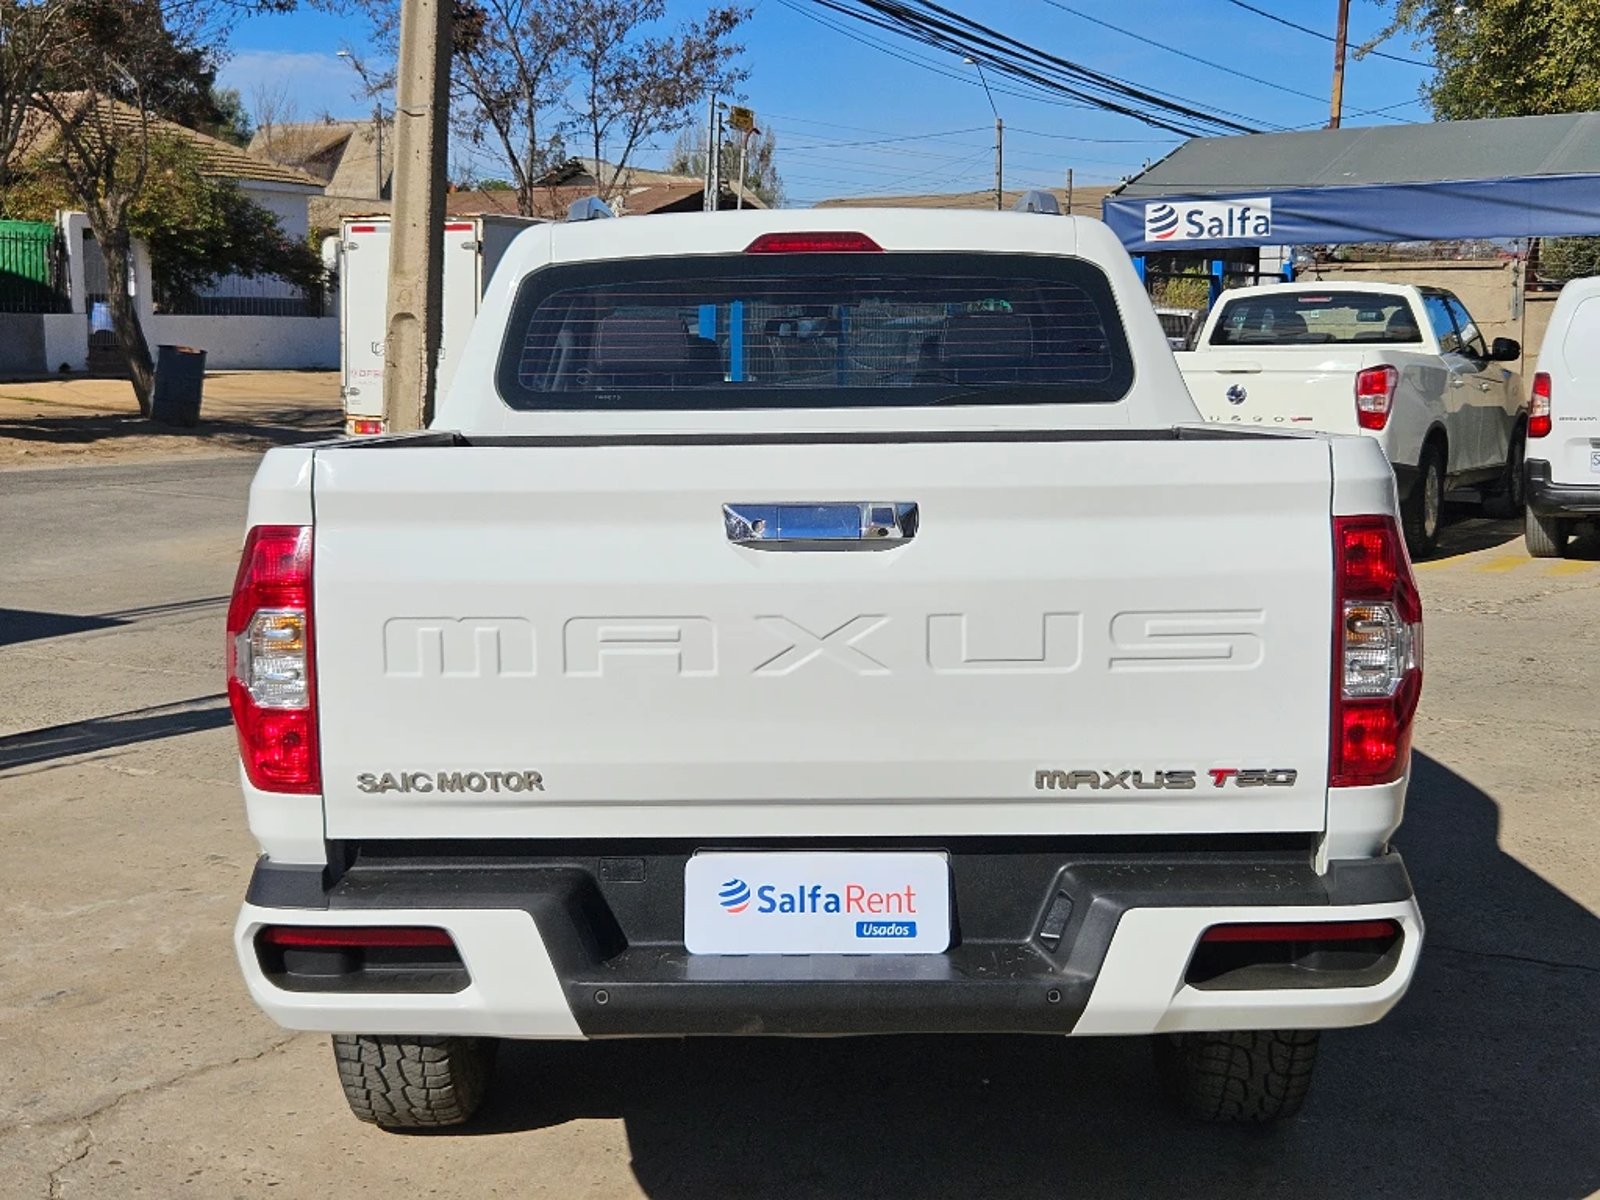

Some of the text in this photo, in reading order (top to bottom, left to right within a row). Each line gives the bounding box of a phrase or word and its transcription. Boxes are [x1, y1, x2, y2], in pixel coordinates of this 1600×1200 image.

[1185, 206, 1270, 238] Salfa
[382, 608, 1267, 677] MAXUS
[356, 770, 545, 793] SAIC MOTOR
[1034, 769, 1197, 790] MAXUS
[862, 923, 910, 936] Usados
